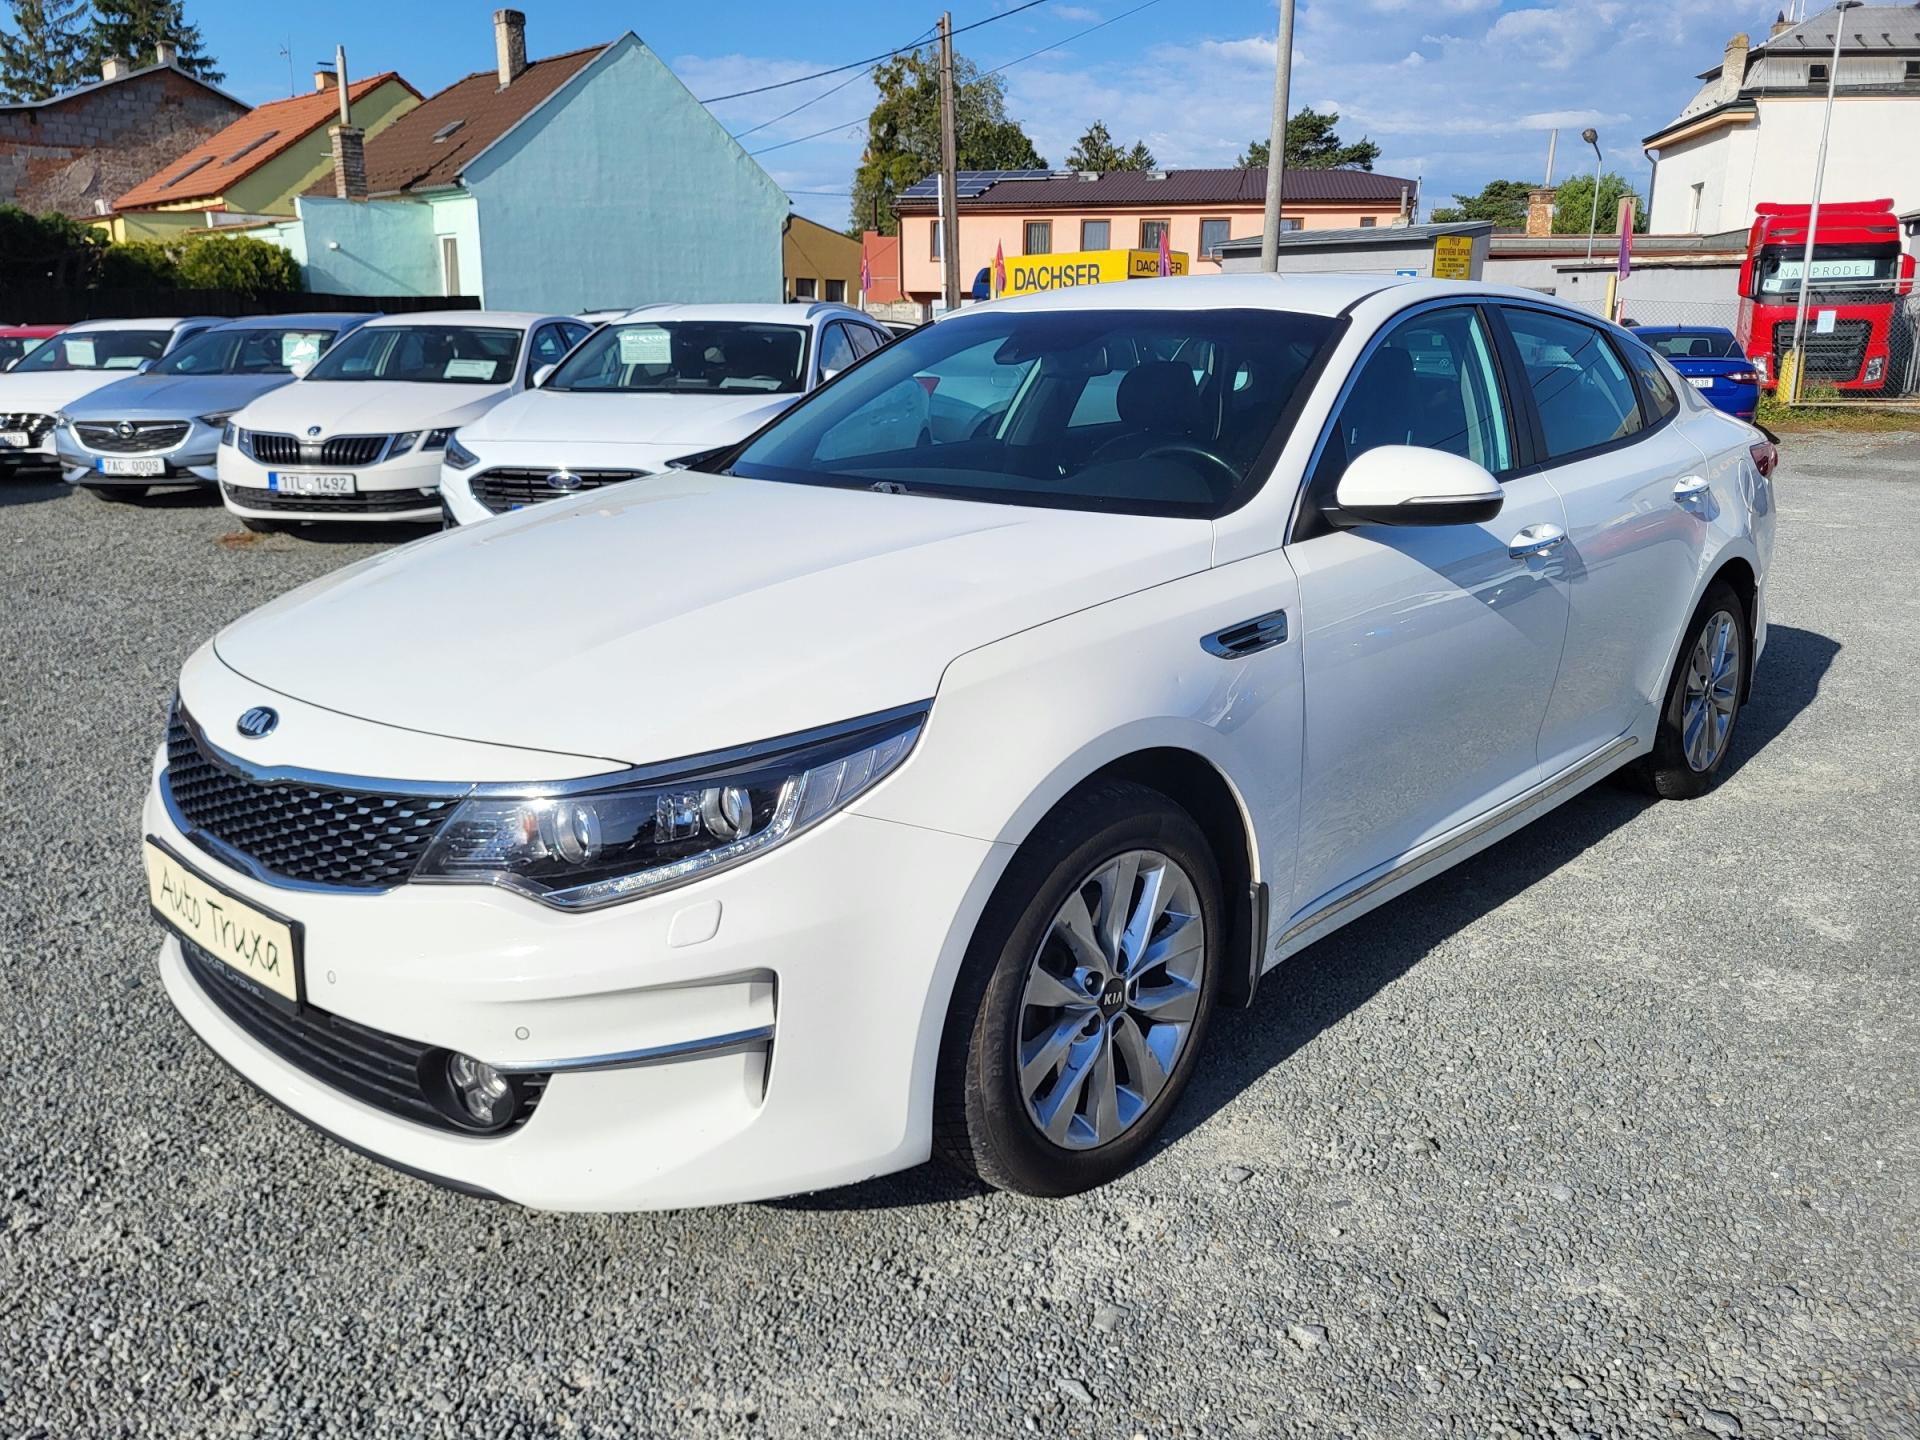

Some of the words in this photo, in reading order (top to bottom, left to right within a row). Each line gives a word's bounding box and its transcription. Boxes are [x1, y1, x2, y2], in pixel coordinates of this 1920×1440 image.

[1136, 260, 1183, 275] DACHER
[1781, 268, 1799, 277] NA
[1812, 265, 1871, 277] PRODEJ
[1014, 264, 1100, 291] DACHSER
[105, 460, 125, 471] 7AC
[131, 460, 159, 471] 0009
[281, 476, 305, 490] 1TL
[315, 477, 347, 491] 1492
[160, 866, 201, 929] Auto
[205, 898, 281, 978] Truxa
[1103, 991, 1123, 1006] KIA
